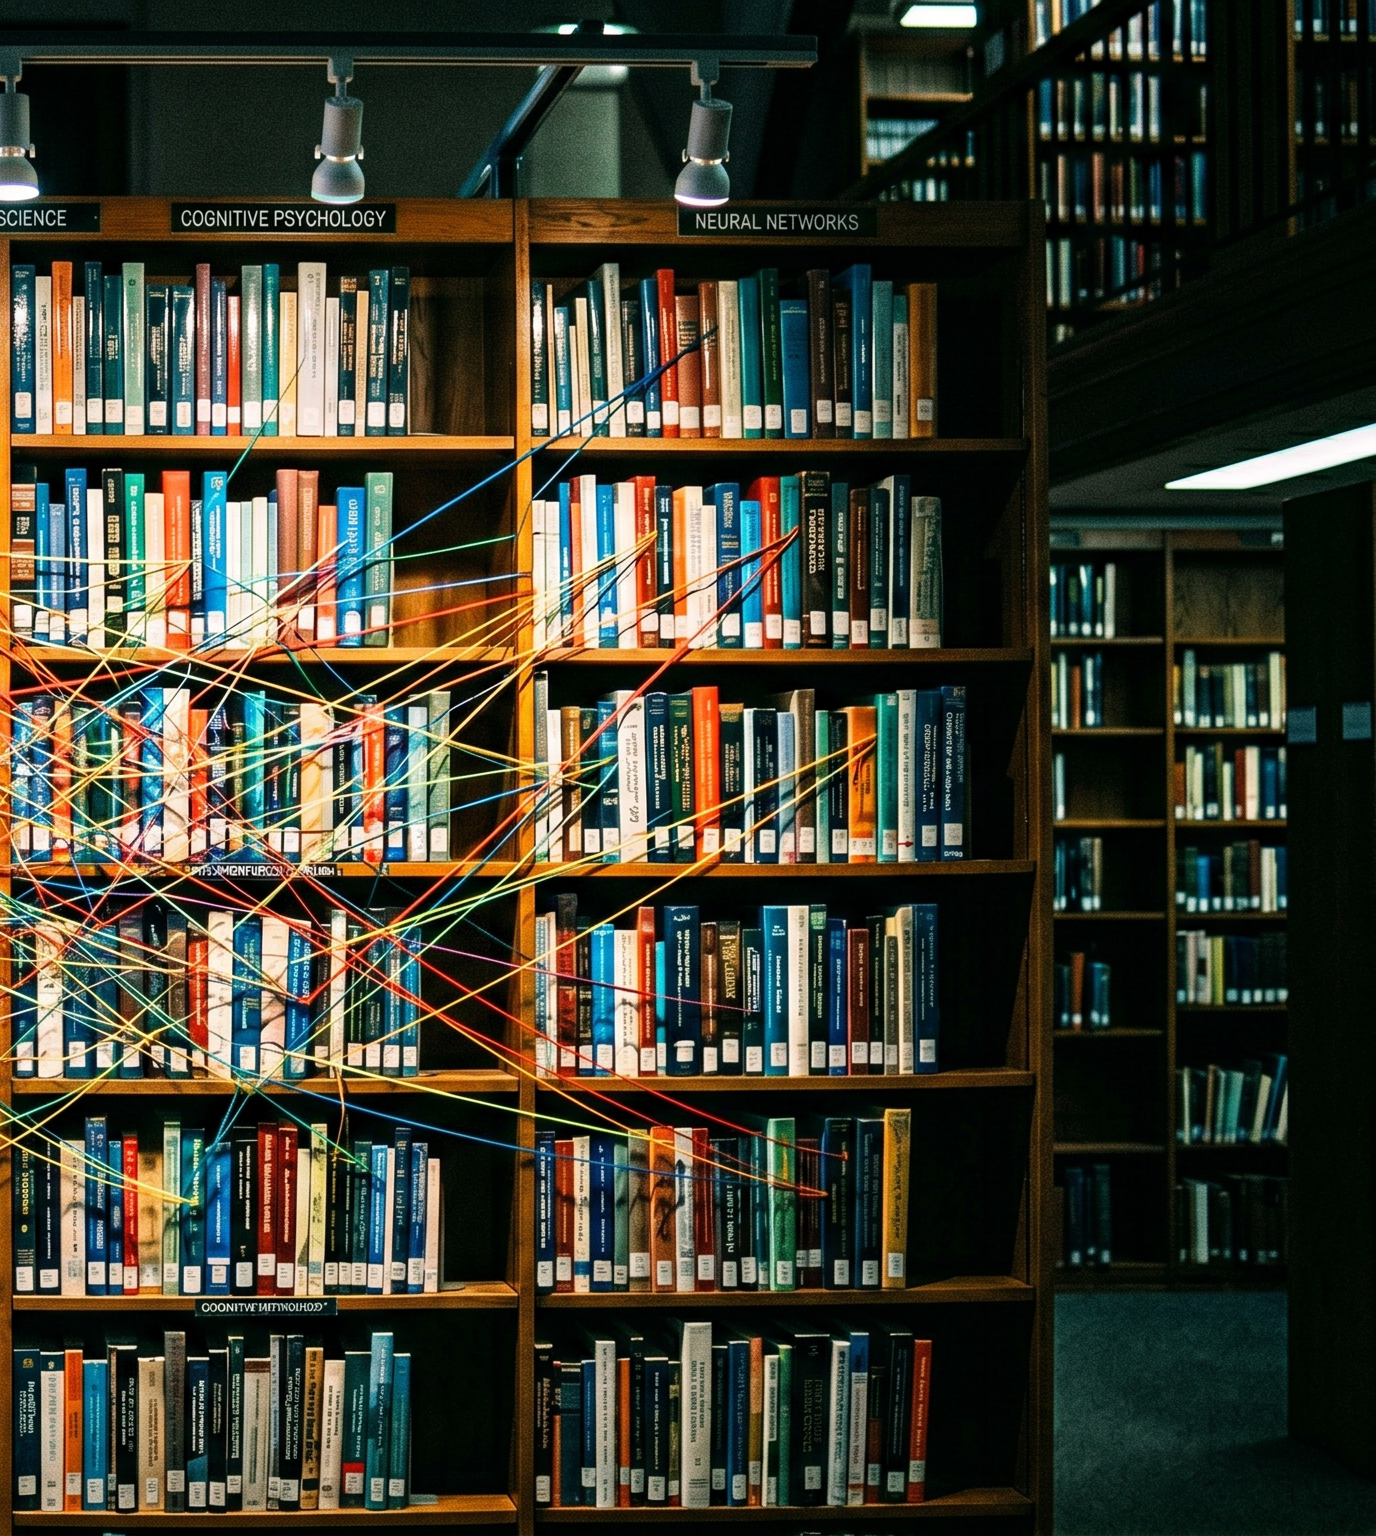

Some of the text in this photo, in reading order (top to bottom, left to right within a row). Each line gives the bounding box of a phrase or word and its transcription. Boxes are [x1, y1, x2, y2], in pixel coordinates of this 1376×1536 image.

[181, 209, 387, 228] COGNITIVE PSYCHOLOGY
[695, 213, 860, 231] NEURAL NETWORKS
